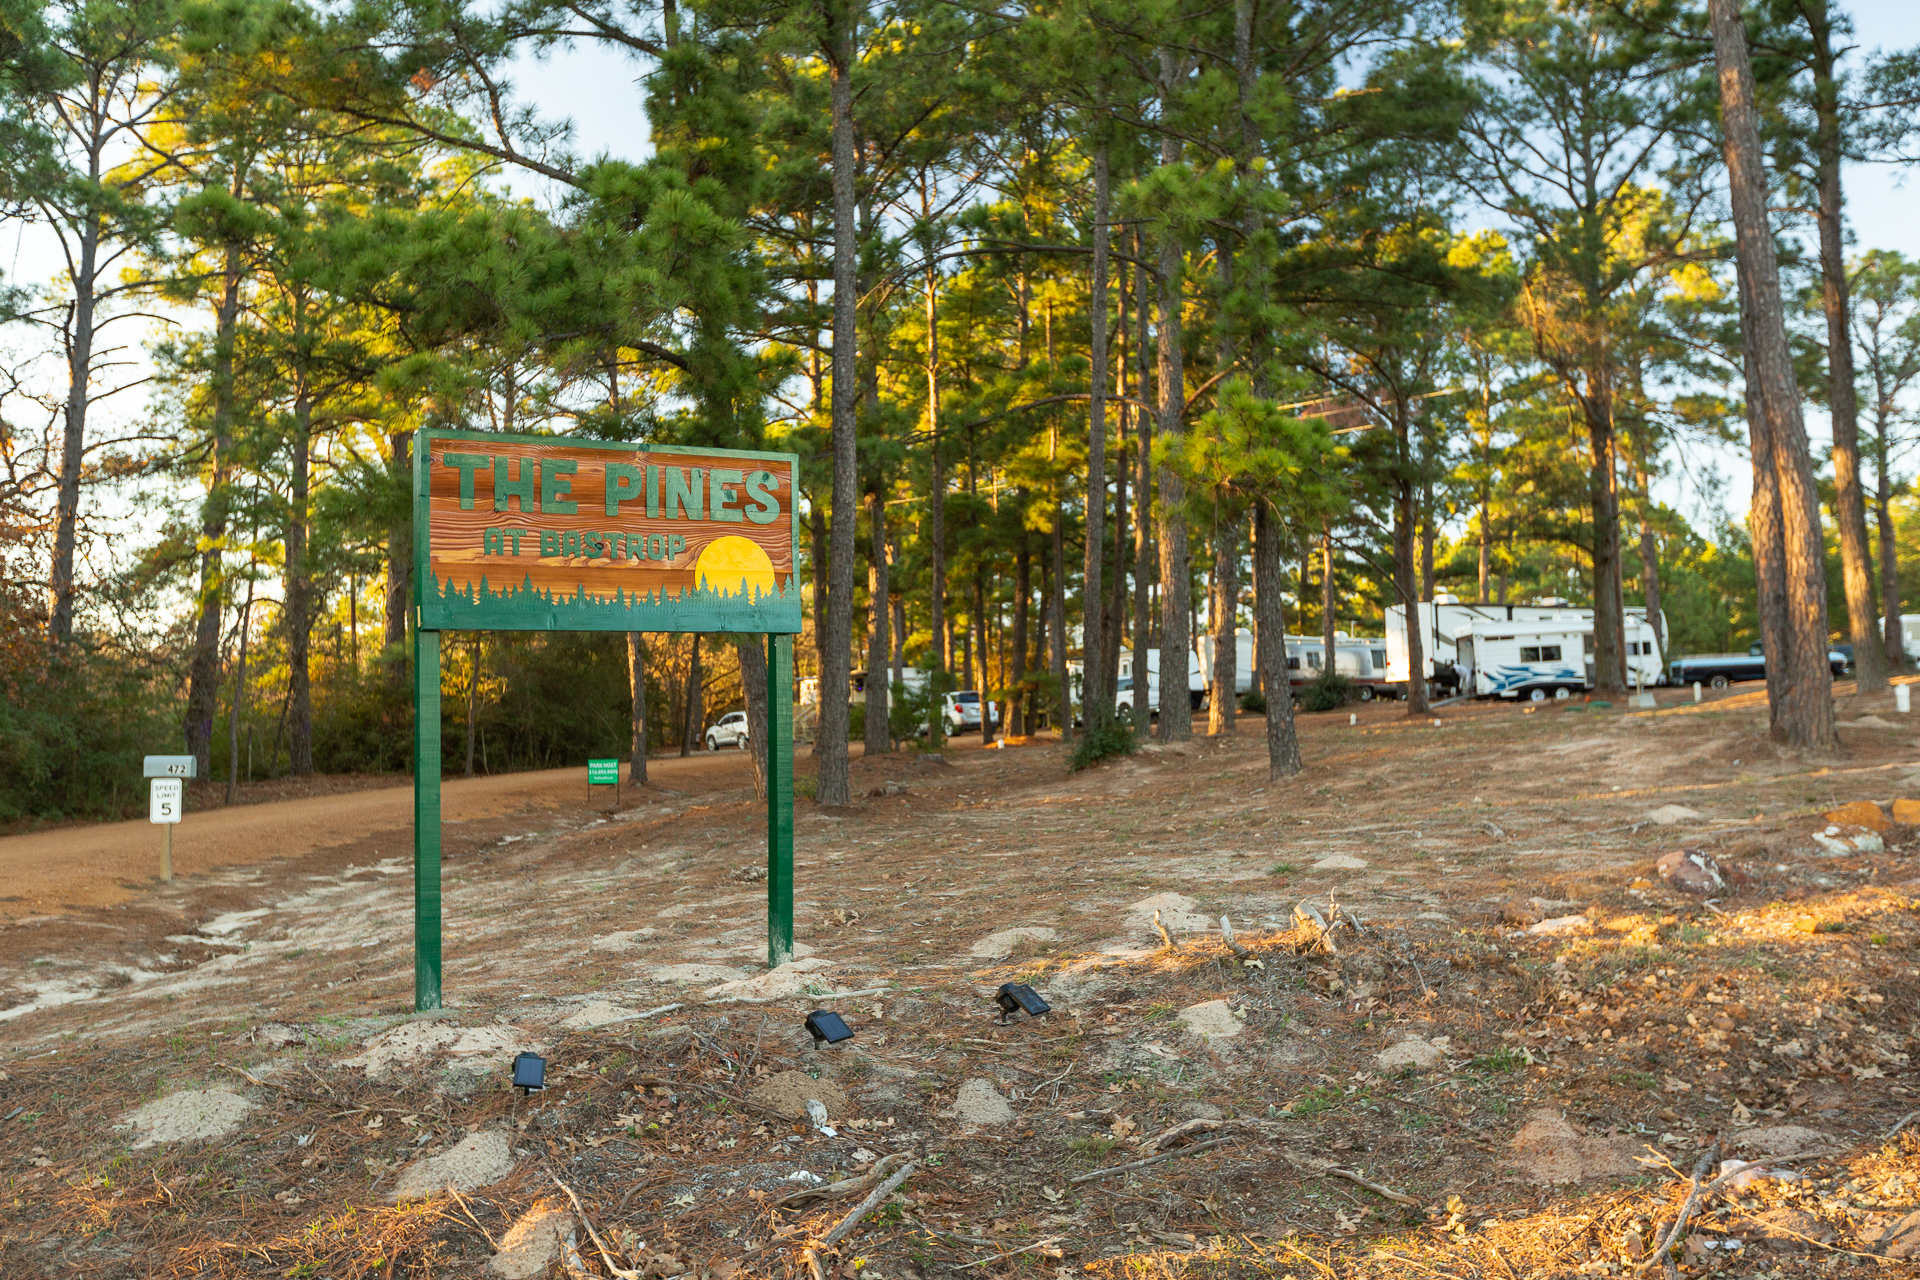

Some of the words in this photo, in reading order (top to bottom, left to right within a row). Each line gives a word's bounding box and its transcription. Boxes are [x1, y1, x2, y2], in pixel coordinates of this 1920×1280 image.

[443, 453, 578, 515] THE
[605, 462, 781, 525] PINES
[484, 527, 527, 556] AT
[540, 530, 686, 561] BASTROP
[168, 765, 186, 774] 472
[162, 803, 171, 815] 5
